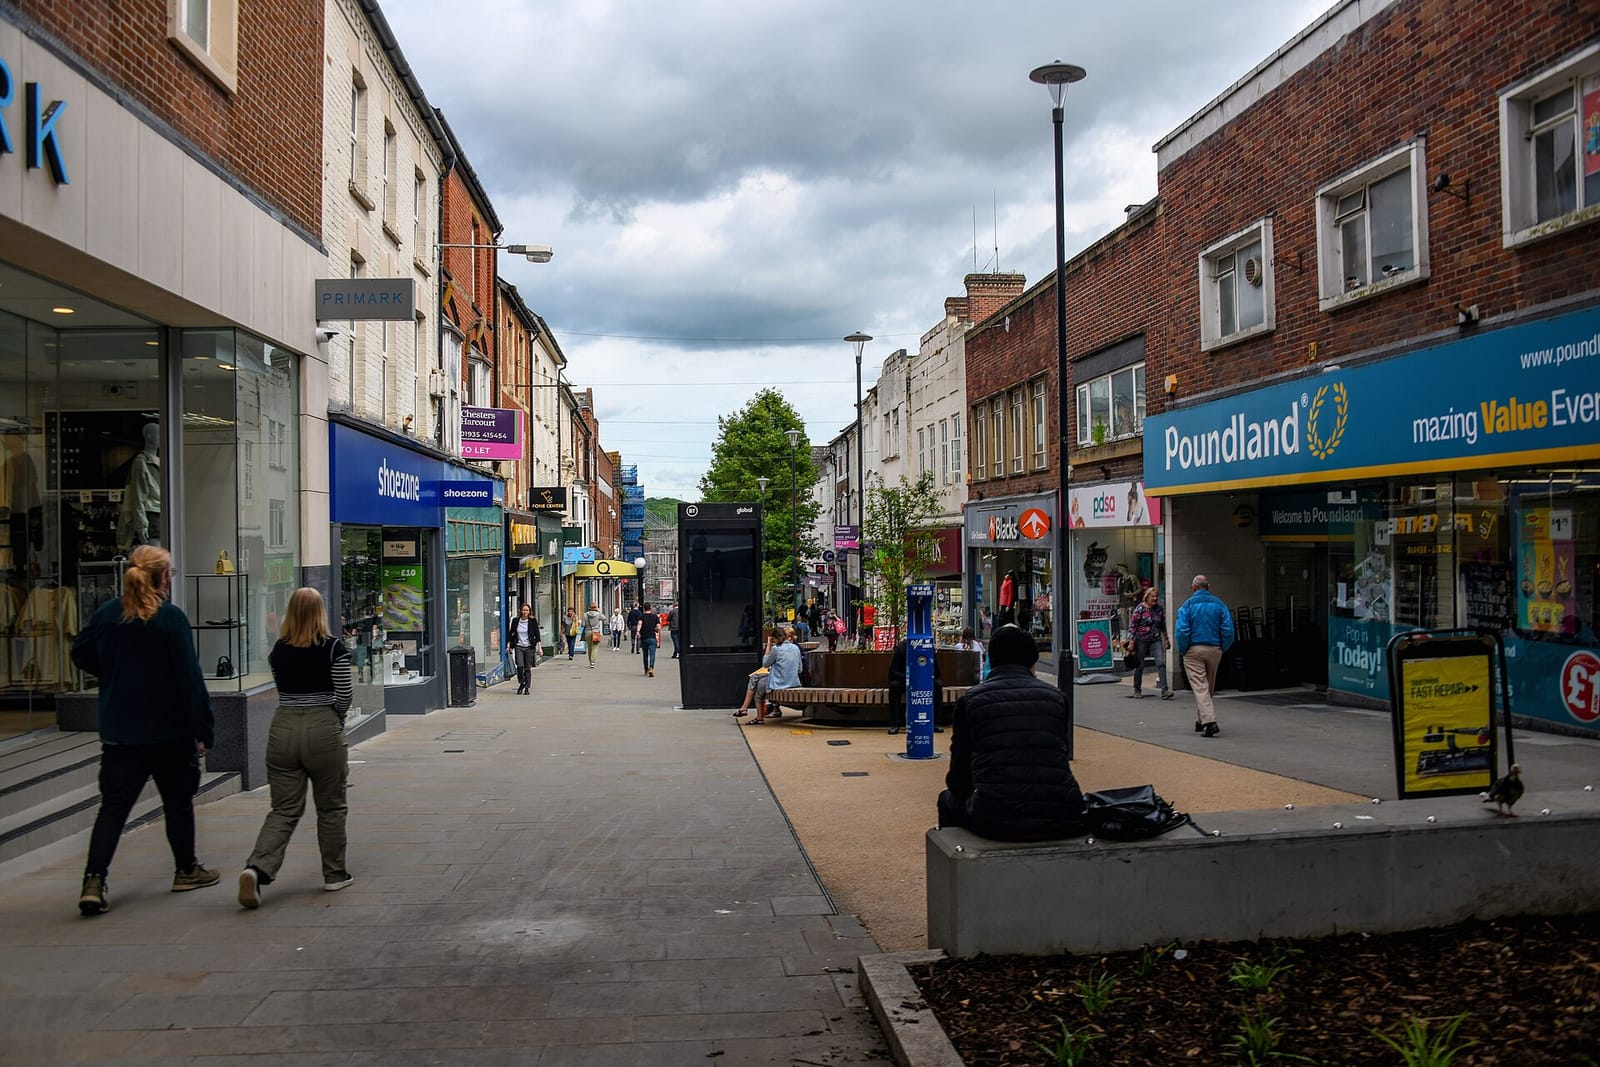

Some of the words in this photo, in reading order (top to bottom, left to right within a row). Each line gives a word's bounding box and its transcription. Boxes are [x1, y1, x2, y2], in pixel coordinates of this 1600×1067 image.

[323, 292, 402, 304] PRIMARK
[460, 410, 496, 420] Chesters
[460, 418, 496, 427] Harcourt
[1413, 407, 1478, 445] mazing
[1480, 397, 1548, 434] Value
[1165, 401, 1299, 471] Poundland
[378, 457, 420, 501] shoezone
[443, 488, 489, 498] shoezone
[736, 506, 753, 515] global
[1093, 491, 1115, 519] pdsa
[1272, 509, 1303, 524] Welcome
[1303, 509, 1311, 523] to
[1312, 506, 1363, 523] Poundland
[995, 516, 1018, 540] Blacks
[597, 561, 610, 575] Q
[1336, 641, 1382, 675] Today!
[1411, 685, 1432, 699] FAST
[1434, 682, 1464, 697] REPAIR
